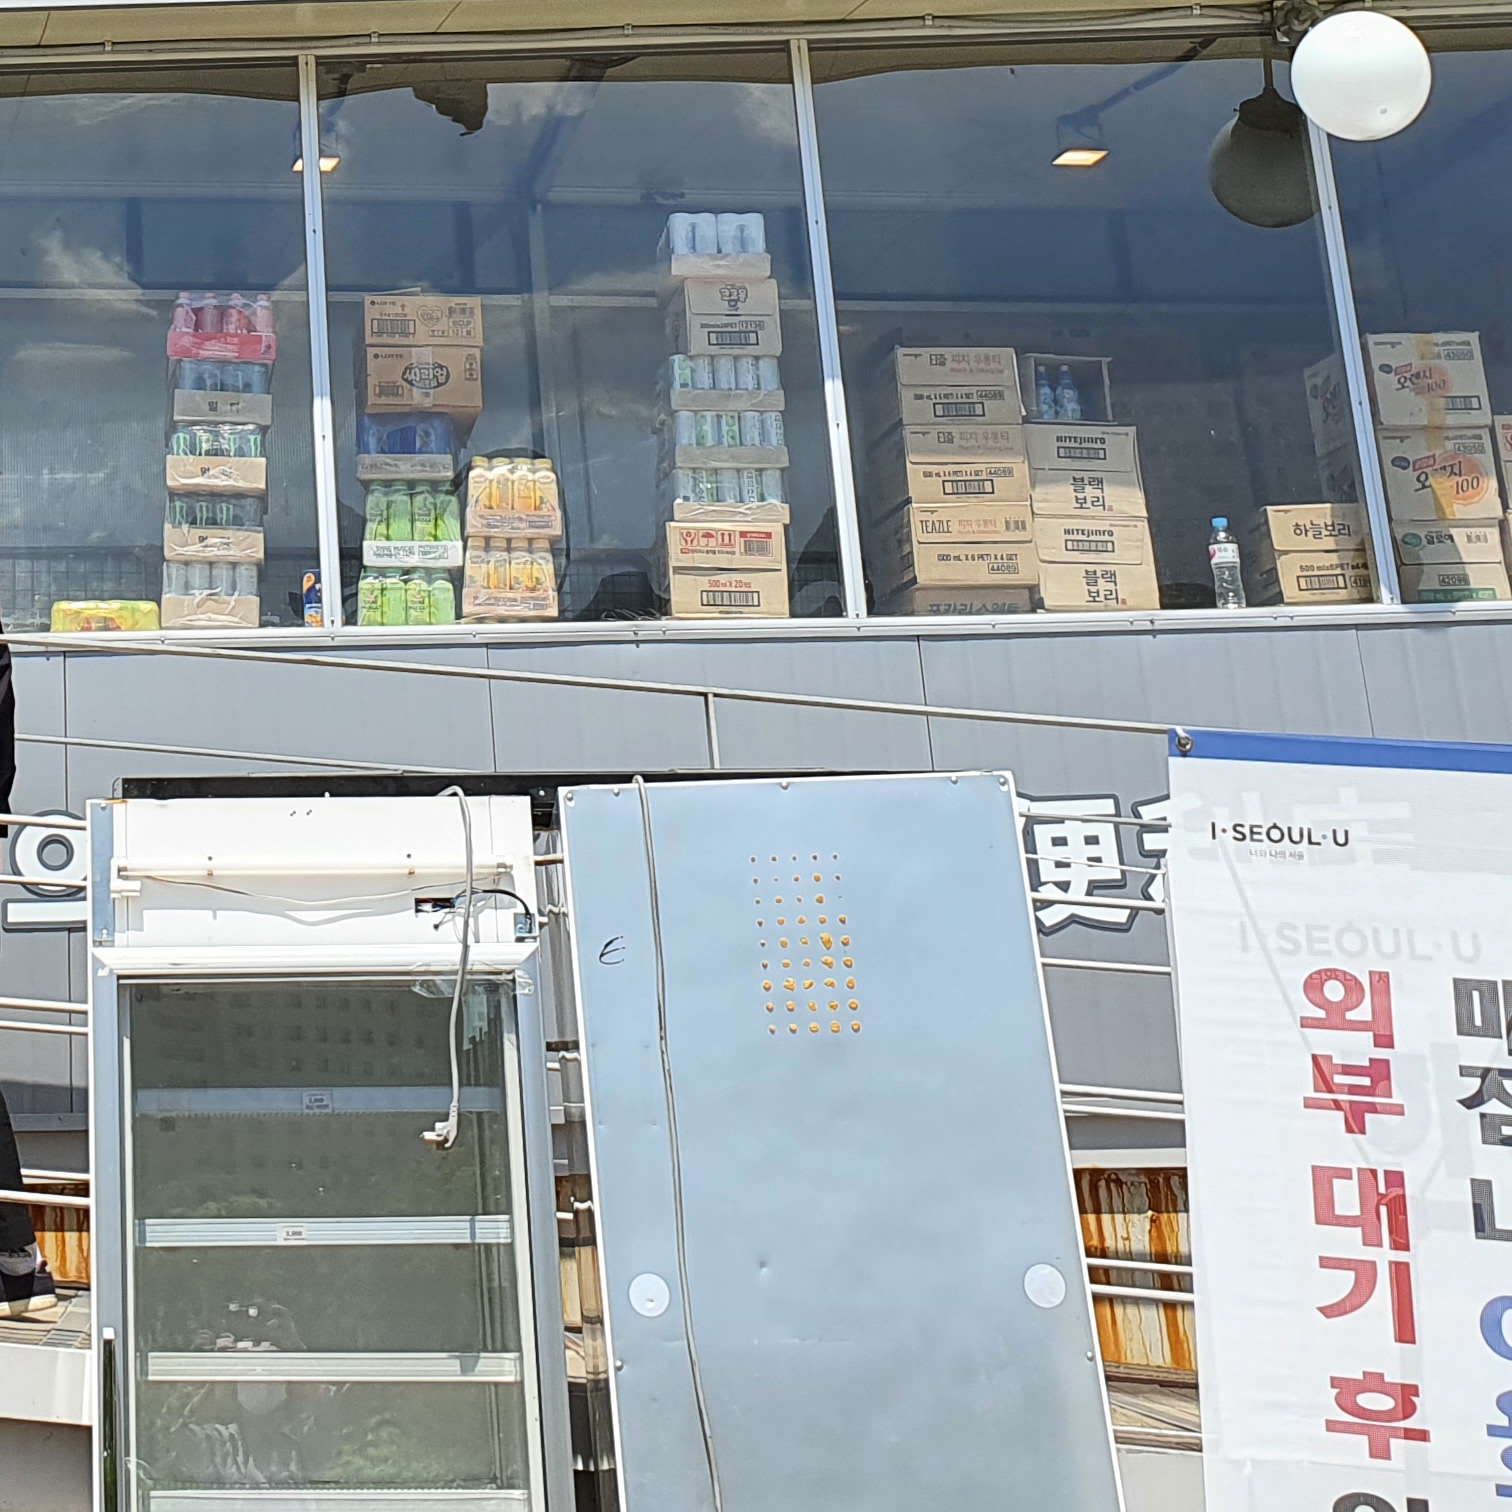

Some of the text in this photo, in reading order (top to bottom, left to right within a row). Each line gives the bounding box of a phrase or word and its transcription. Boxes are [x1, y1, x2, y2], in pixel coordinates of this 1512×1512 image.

[1070, 475, 1104, 495] 블랙
[1455, 474, 1480, 495] 100
[1073, 495, 1107, 512] 보리
[919, 519, 953, 534] TEAZLE
[1292, 519, 1352, 540] 하늘보리
[1082, 569, 1117, 587] 블랙
[1085, 588, 1120, 605] 보리
[1299, 967, 1406, 1135] 외부
[1311, 1164, 1417, 1346] 대기
[1325, 1370, 1432, 1461] 후
